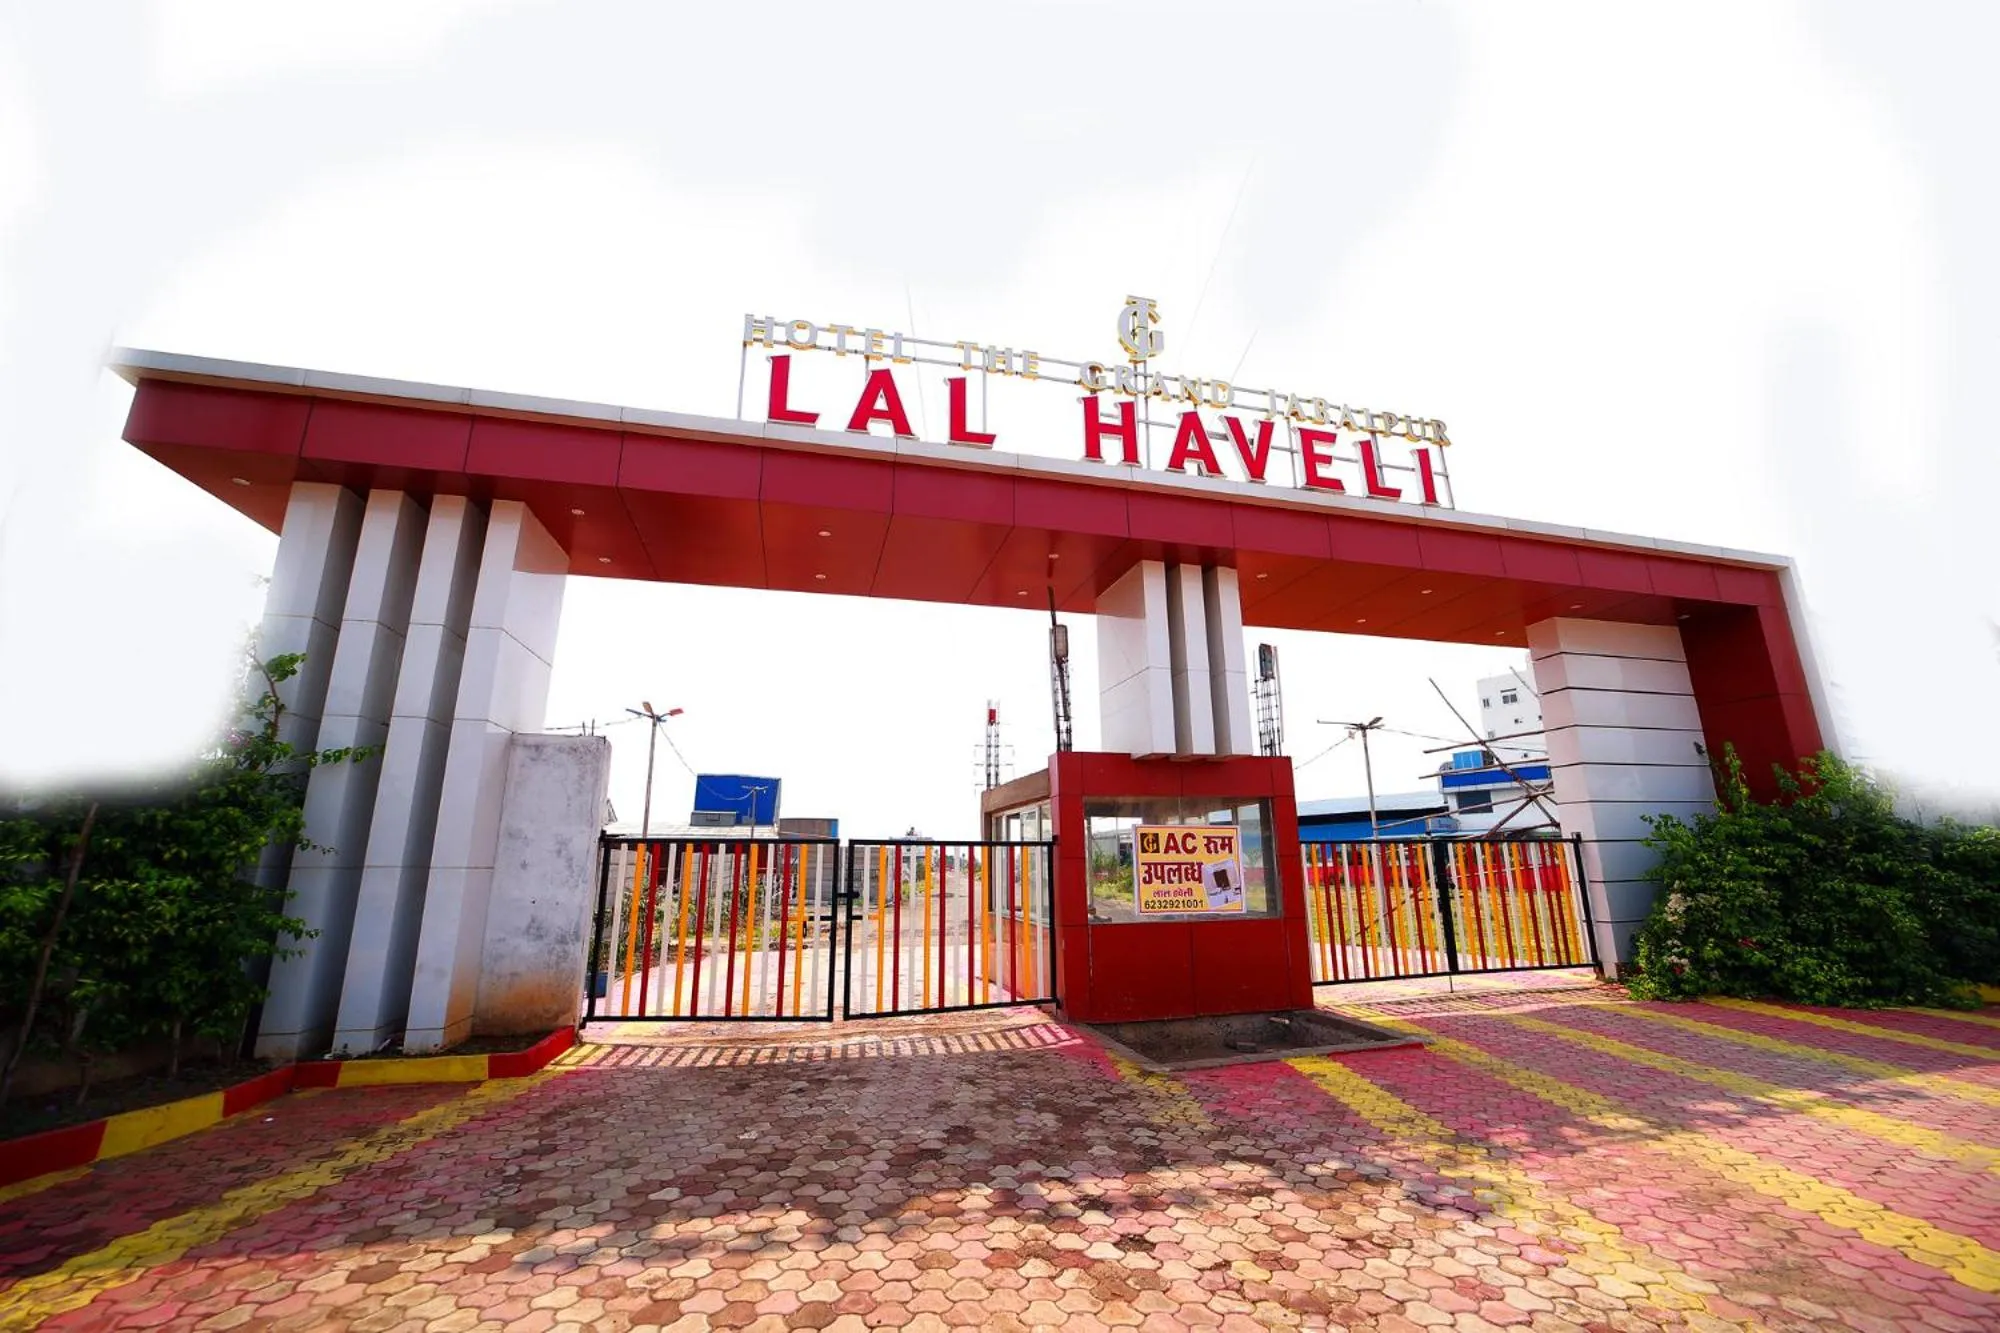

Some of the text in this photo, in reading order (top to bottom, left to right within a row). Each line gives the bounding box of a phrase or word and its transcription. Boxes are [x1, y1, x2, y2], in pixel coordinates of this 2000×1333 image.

[744, 313, 915, 363] HOTEL
[956, 340, 1040, 381] THE
[1079, 360, 1235, 408] GRAND
[767, 354, 1440, 507] LAL HAVELI
[1163, 832, 1198, 854] AC
[1202, 835, 1234, 854] रूम
[1141, 861, 1204, 884] उपलब्ध
[1144, 899, 1204, 910] 6232921001
